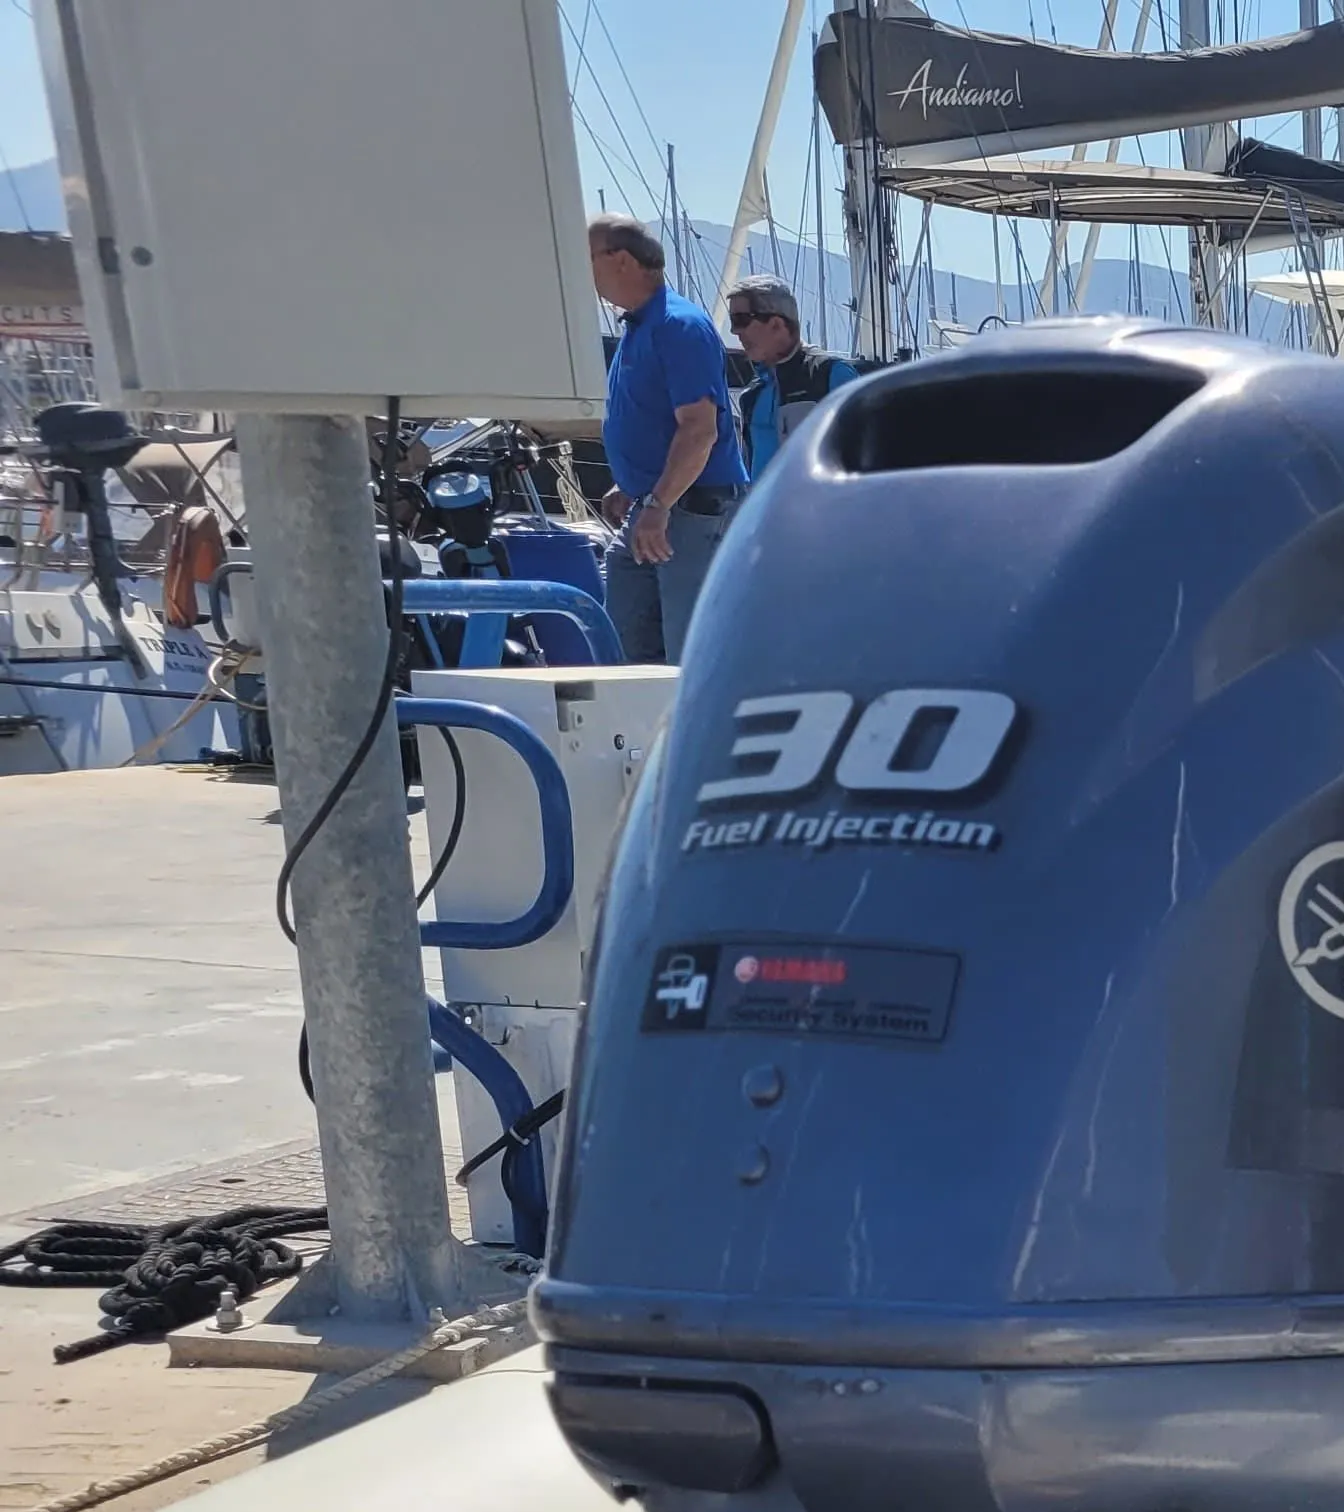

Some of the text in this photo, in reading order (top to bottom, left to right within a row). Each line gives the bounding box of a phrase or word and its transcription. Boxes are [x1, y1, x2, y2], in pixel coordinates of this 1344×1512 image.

[886, 58, 1024, 121] Andiamo!
[696, 688, 1016, 802] 30
[681, 809, 995, 850] Fuel Injection
